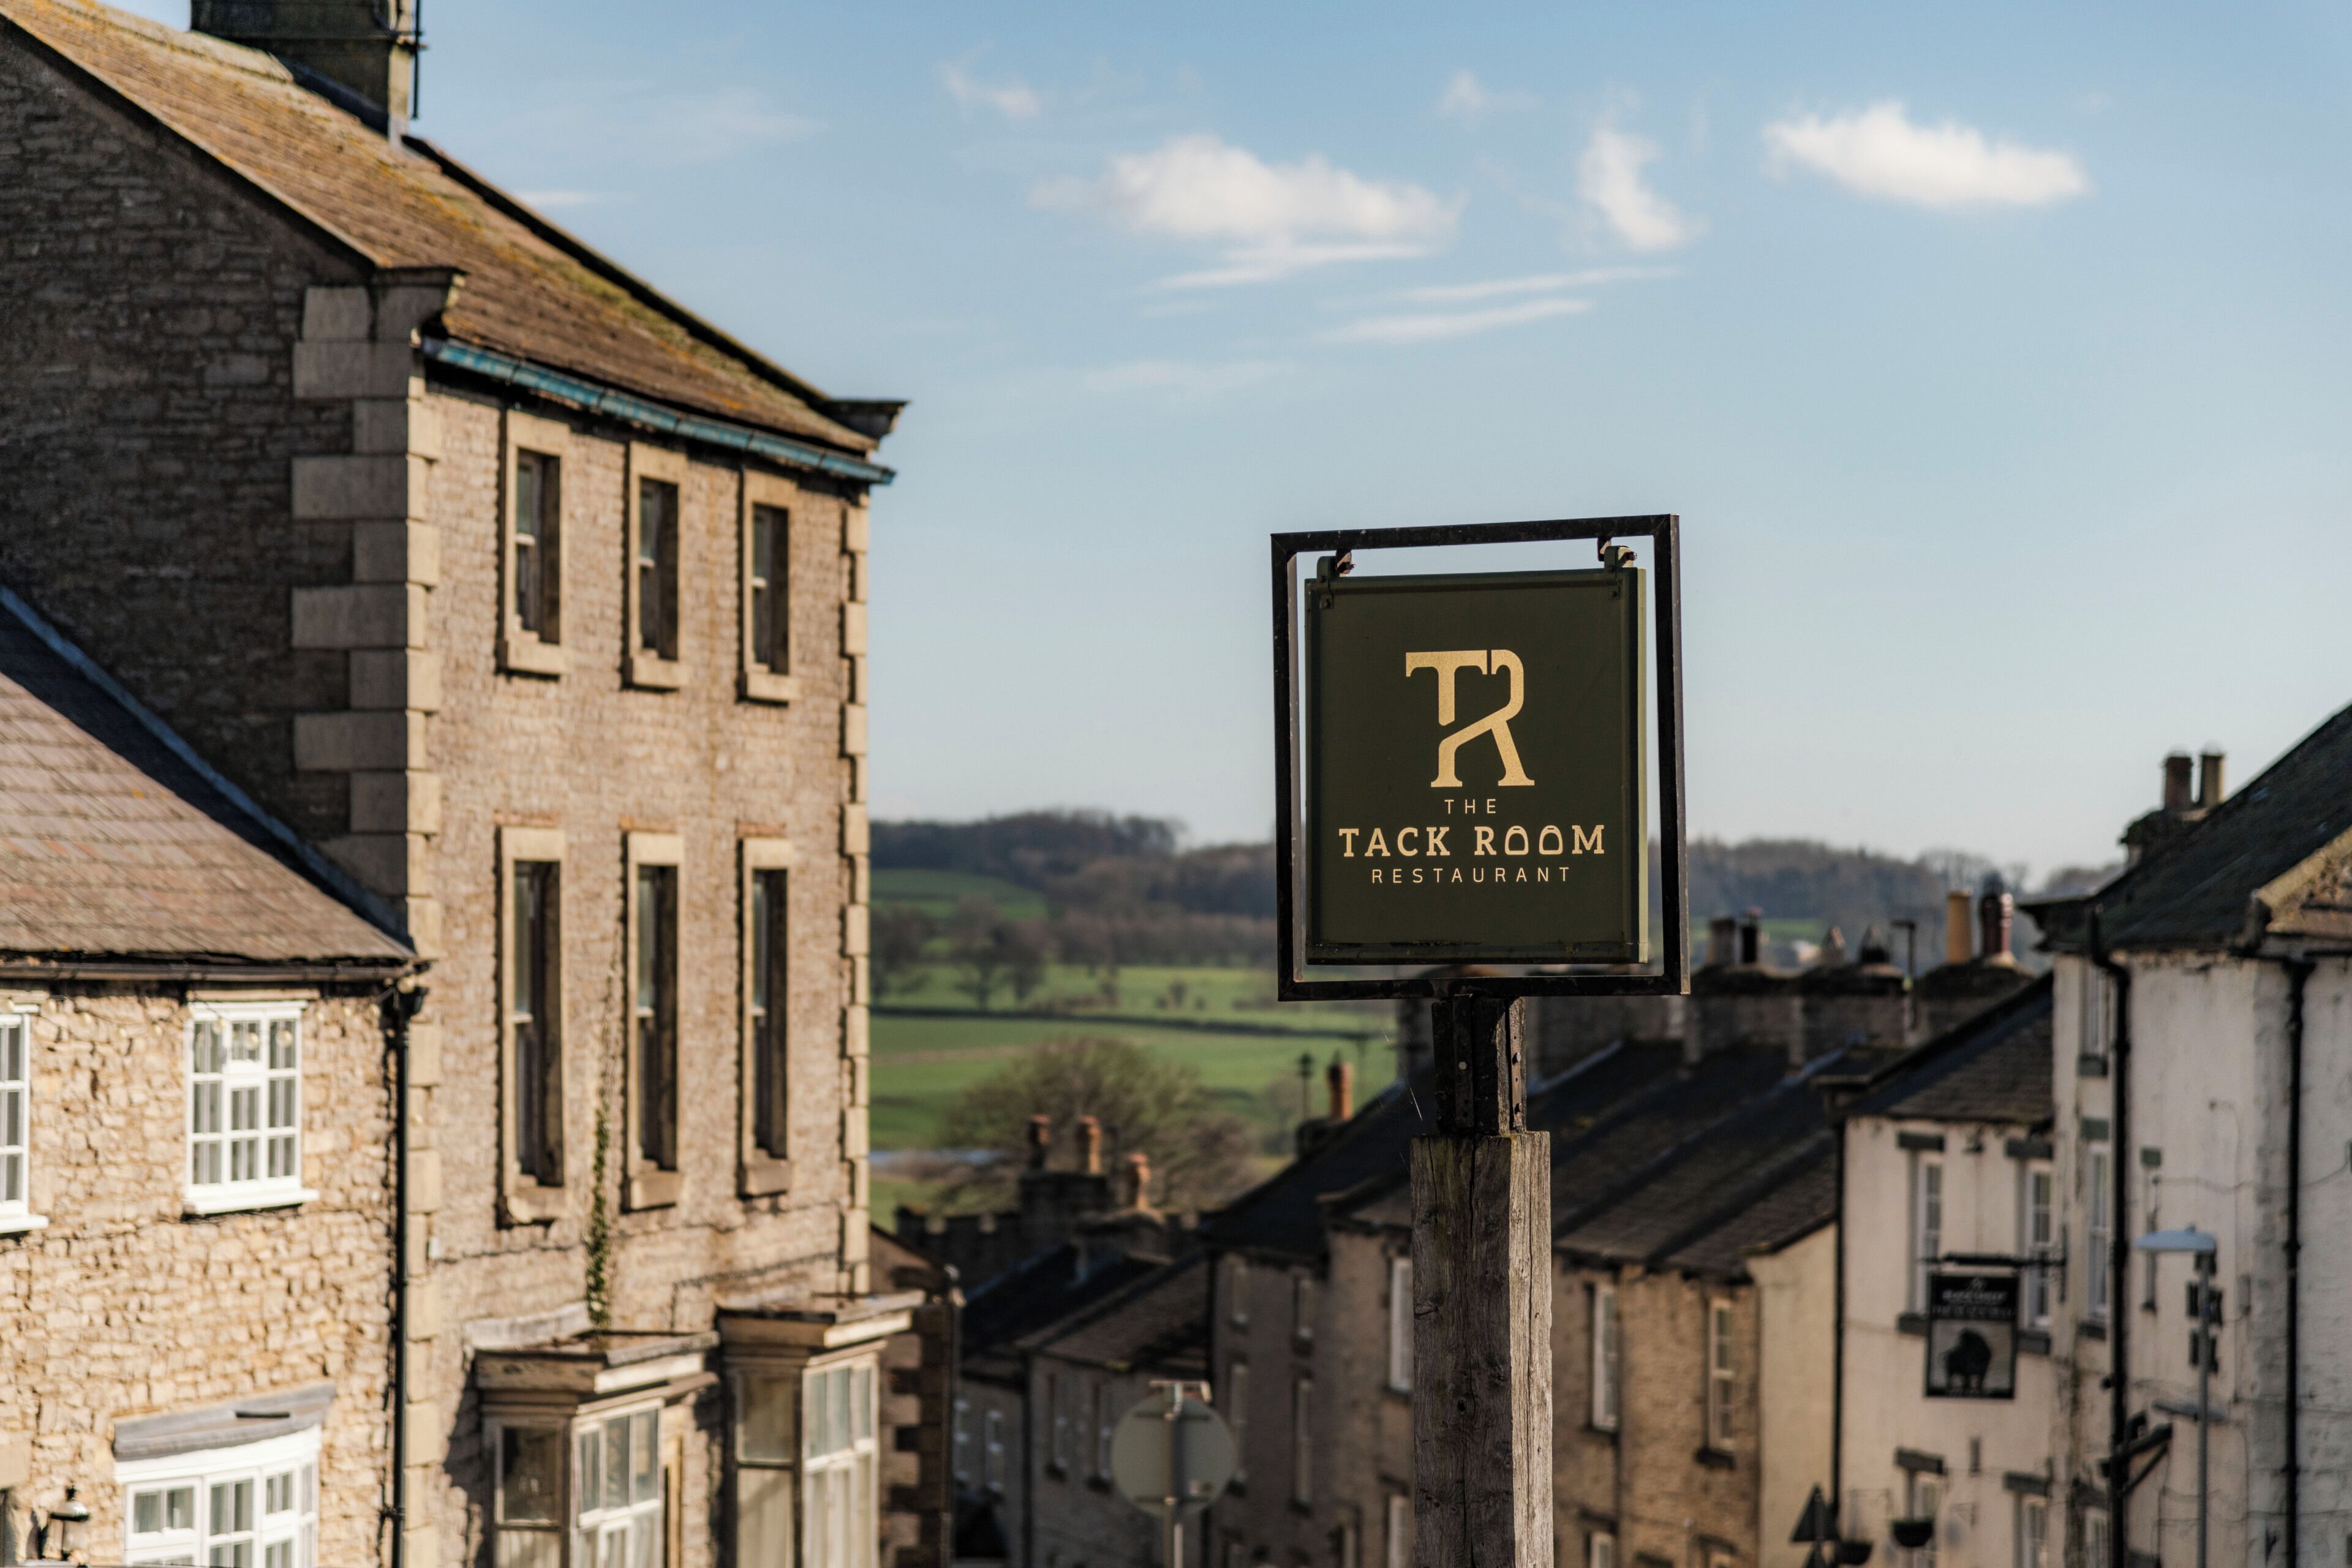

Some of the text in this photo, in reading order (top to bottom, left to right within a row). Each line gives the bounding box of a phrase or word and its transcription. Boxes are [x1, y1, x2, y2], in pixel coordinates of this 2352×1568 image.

[1444, 799, 1496, 815] THE
[1338, 824, 1605, 858] TACK ROOM
[1372, 867, 1570, 884] RESTAURANT
